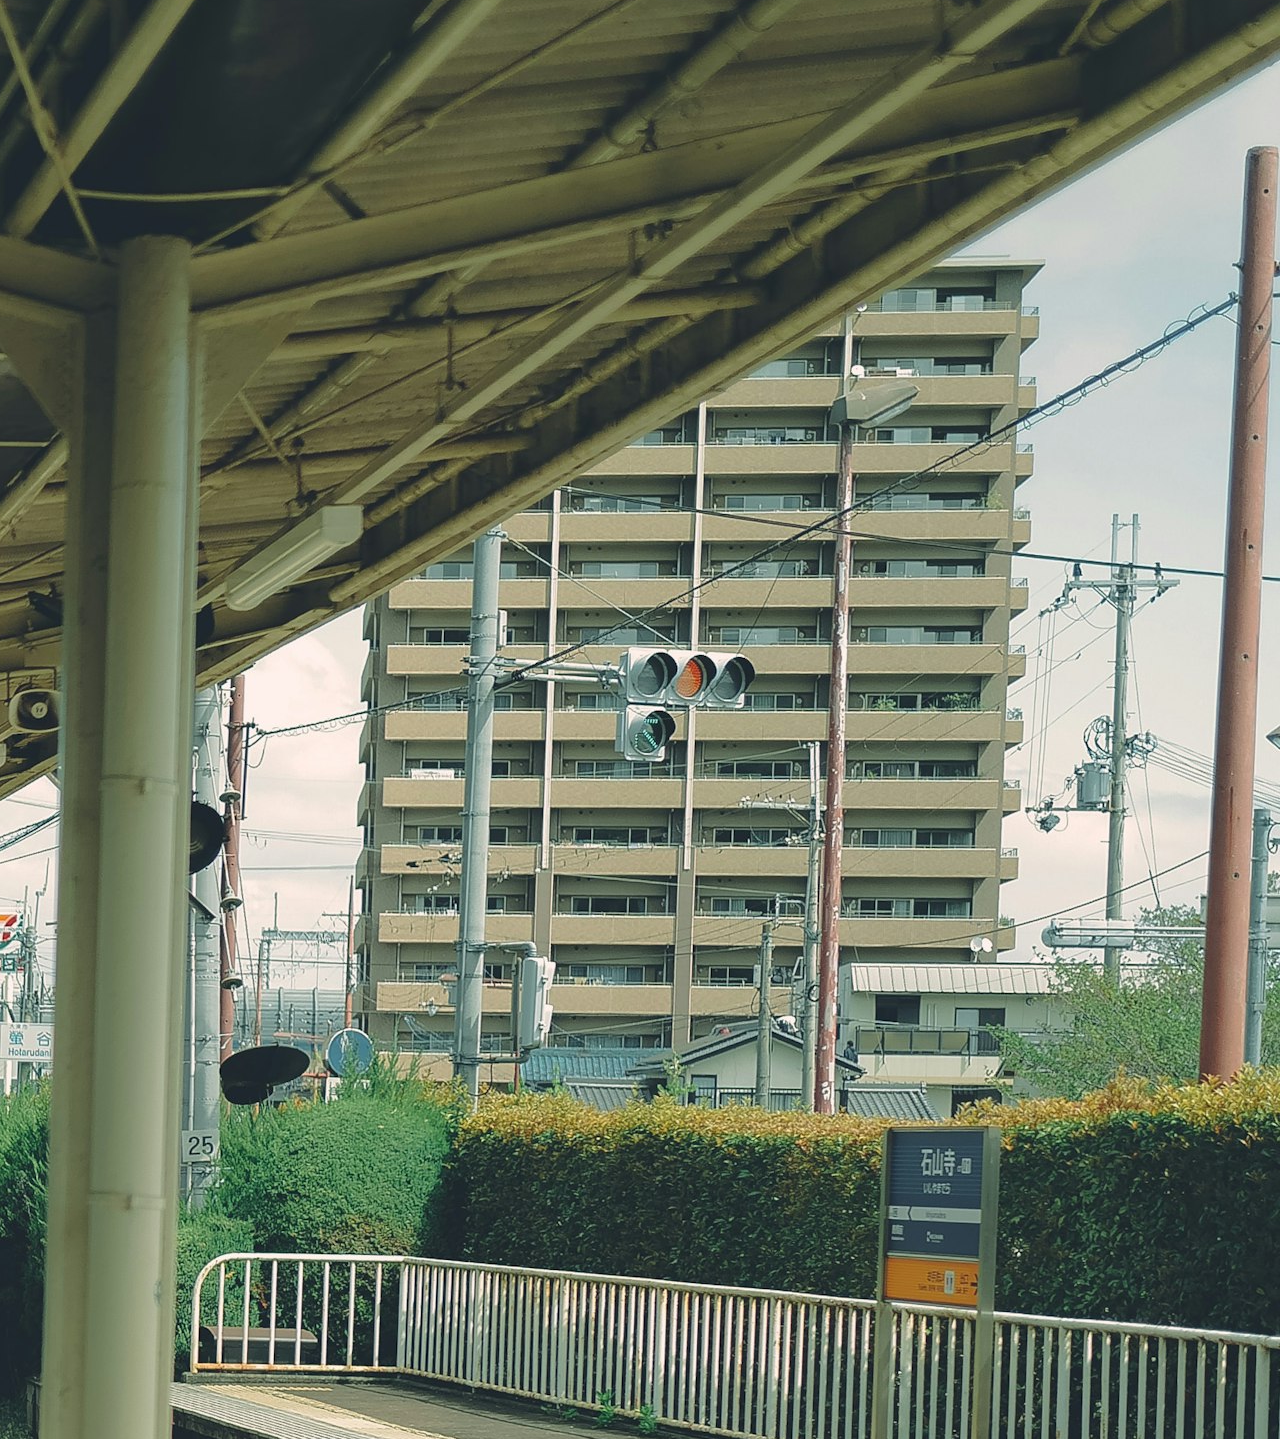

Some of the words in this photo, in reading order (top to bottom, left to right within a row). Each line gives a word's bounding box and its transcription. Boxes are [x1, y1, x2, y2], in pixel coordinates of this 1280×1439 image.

[8, 1047, 52, 1057] Hotarudani
[188, 1135, 214, 1156] 25
[920, 1148, 956, 1176] 石山寺
